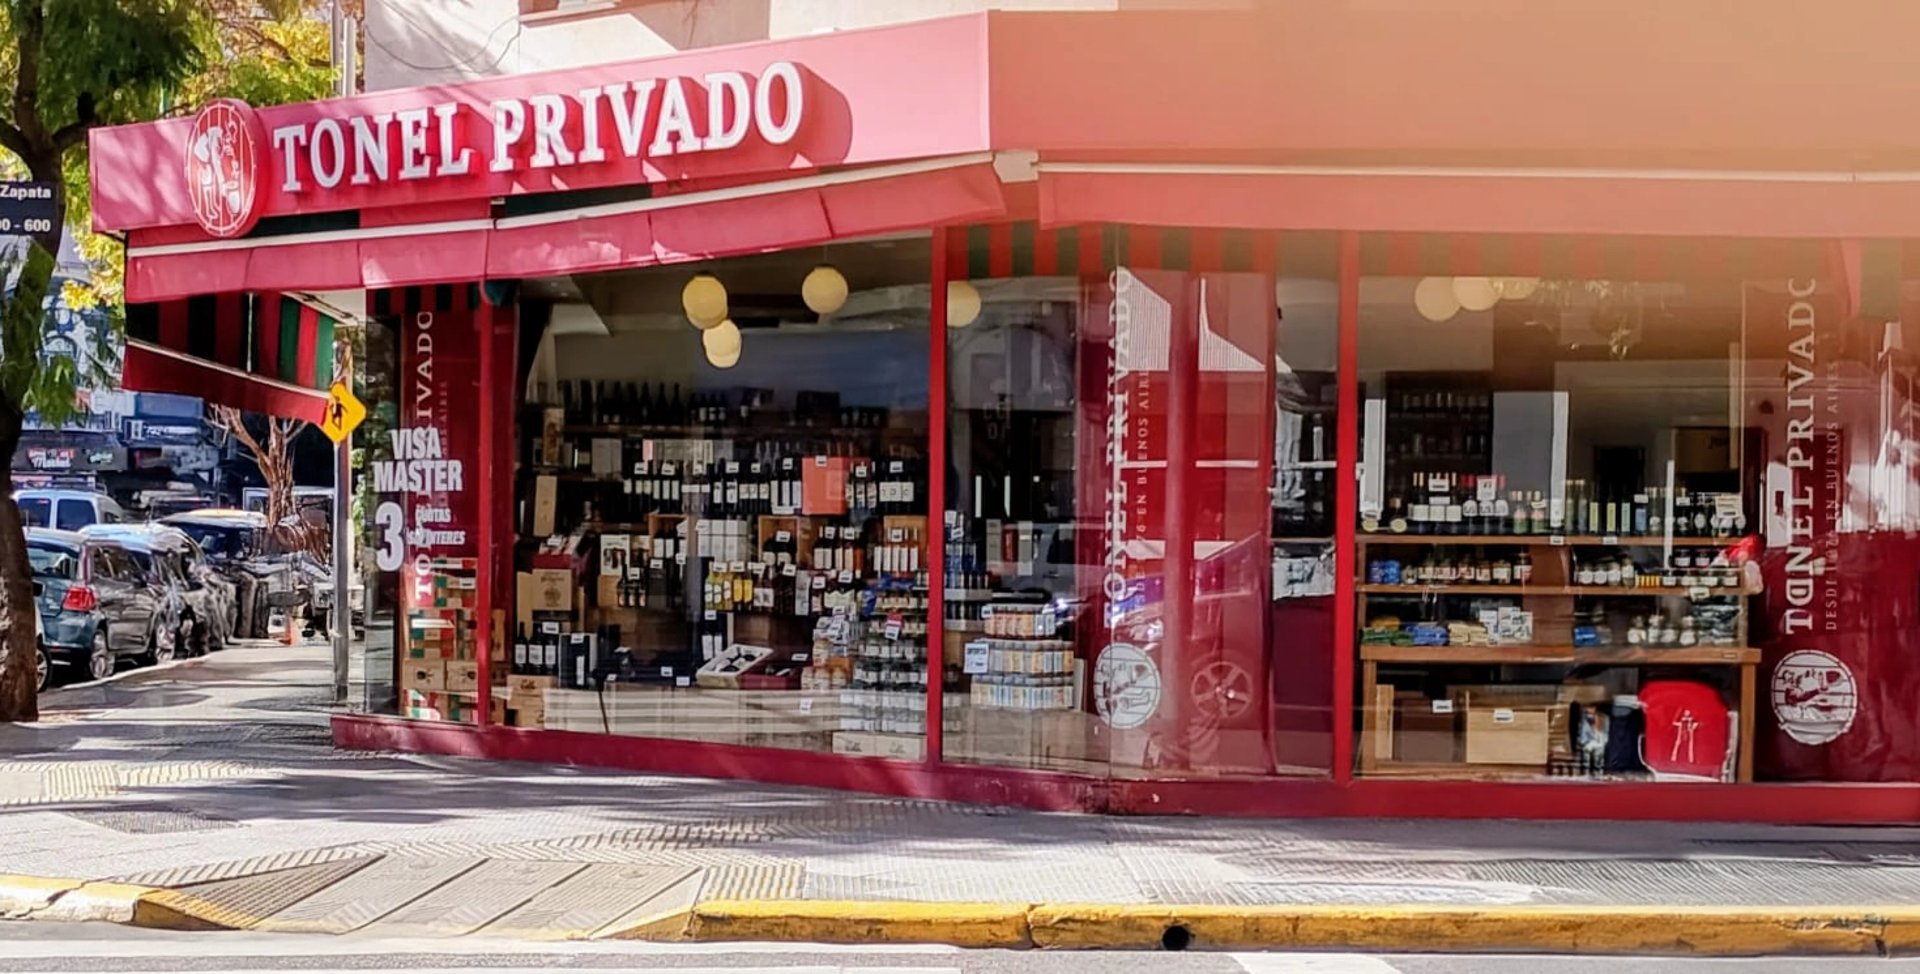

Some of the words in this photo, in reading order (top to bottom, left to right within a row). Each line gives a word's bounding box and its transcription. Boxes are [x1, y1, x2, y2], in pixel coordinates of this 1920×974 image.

[273, 102, 474, 192] TONEL
[489, 61, 803, 173] PRIVADO
[0, 184, 51, 201] Zapata
[0, 218, 11, 231] 0
[23, 218, 51, 231] 600
[416, 311, 433, 430] IVADO
[1106, 268, 1130, 466] PRIVADO
[389, 427, 442, 460] VISA
[372, 459, 463, 492] MASTER
[1136, 494, 1148, 515] EN
[375, 501, 404, 572] 3
[1103, 480, 1127, 628] TONEL
